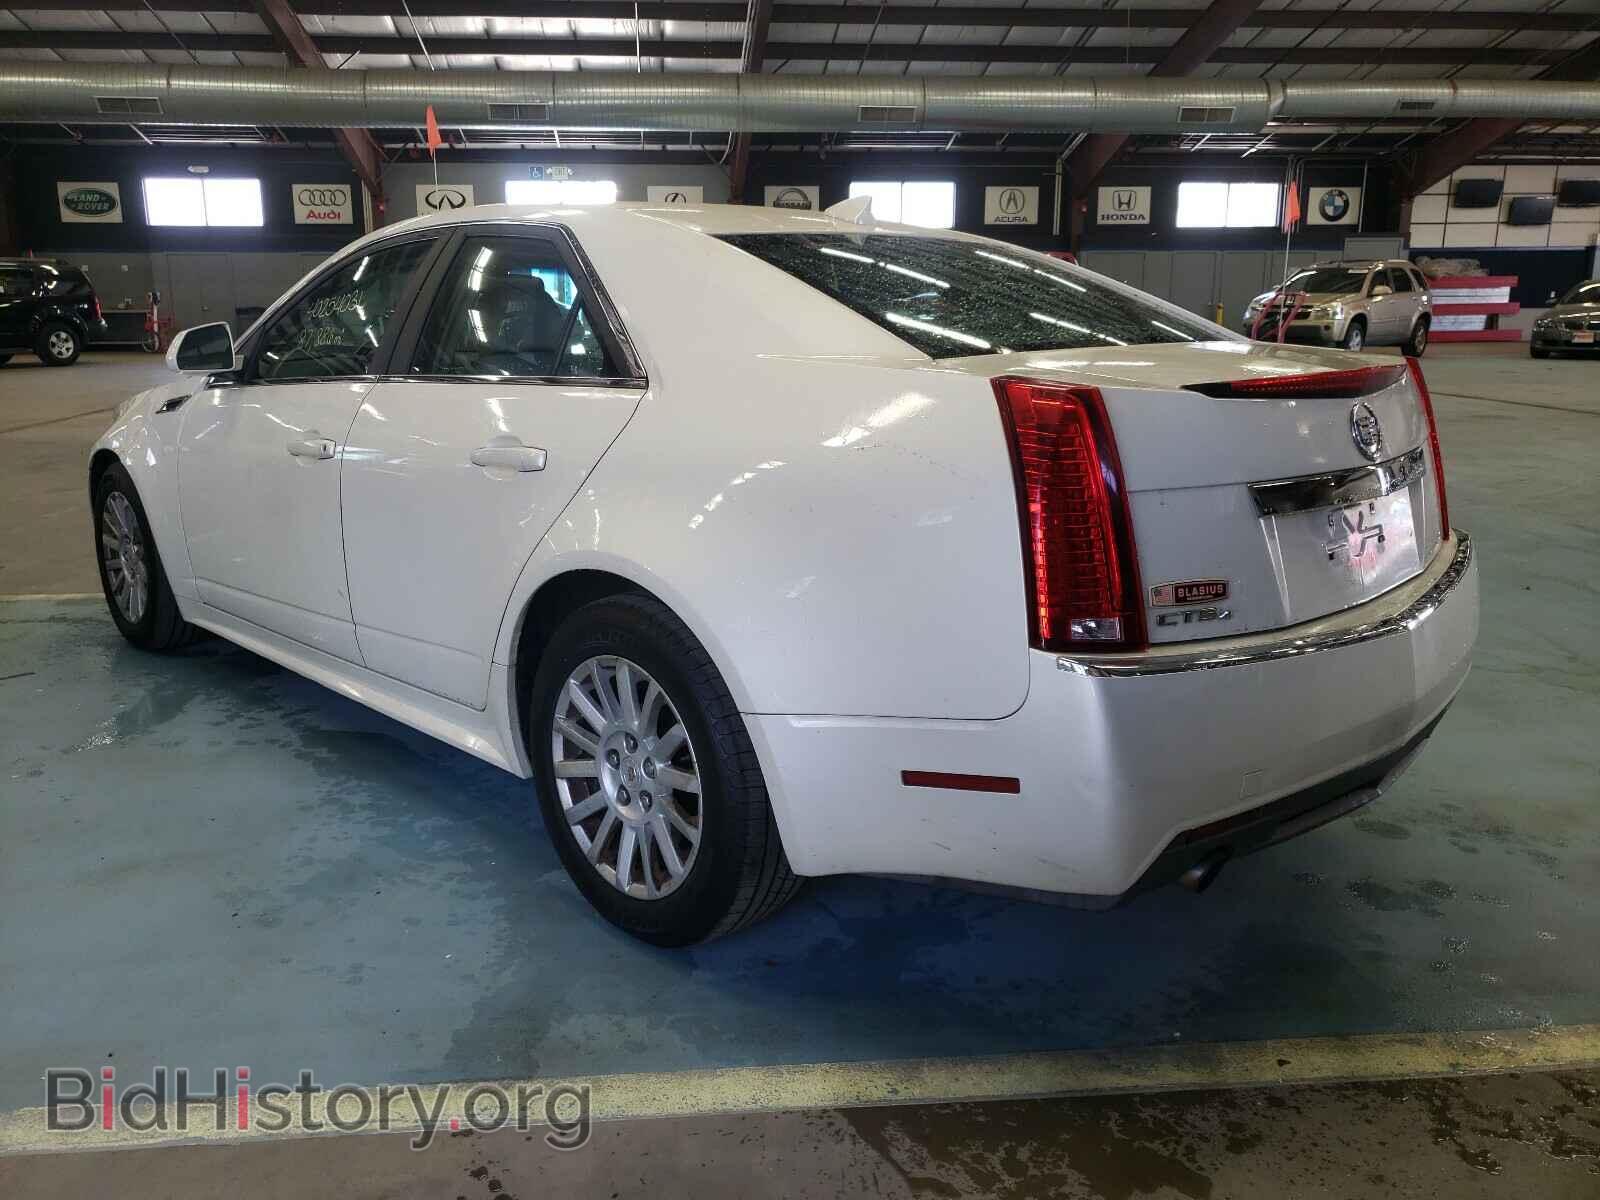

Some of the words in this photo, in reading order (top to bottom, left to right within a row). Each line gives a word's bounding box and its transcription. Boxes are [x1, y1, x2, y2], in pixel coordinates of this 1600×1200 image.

[72, 193, 101, 202] LAND
[77, 201, 111, 211] ROVER
[306, 209, 342, 220] Audi
[994, 215, 1028, 223] ACURA
[1178, 584, 1224, 598] BLASIUS
